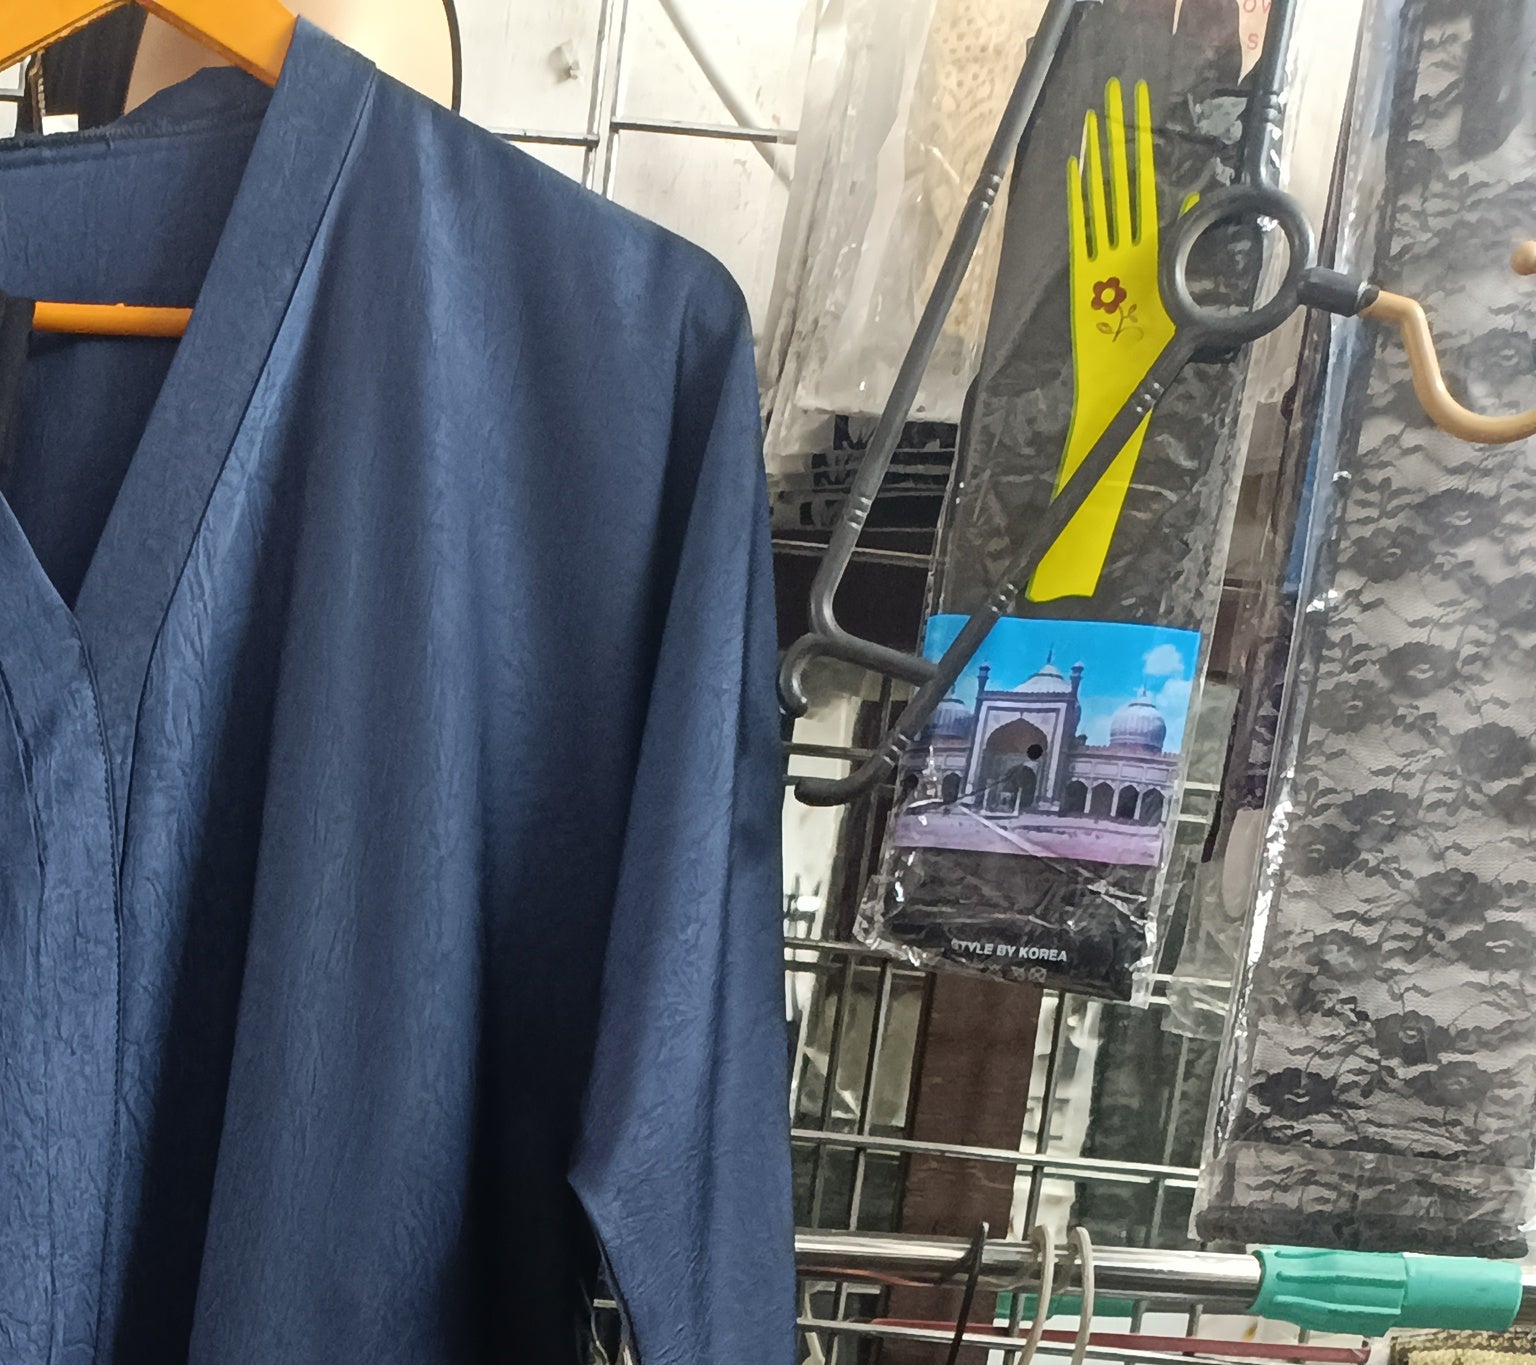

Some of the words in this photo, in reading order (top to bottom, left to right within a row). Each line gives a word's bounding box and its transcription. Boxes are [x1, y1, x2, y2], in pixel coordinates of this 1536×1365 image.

[950, 937, 995, 956] STYLE
[996, 944, 1017, 958] BY
[1018, 945, 1068, 962] KOREA
